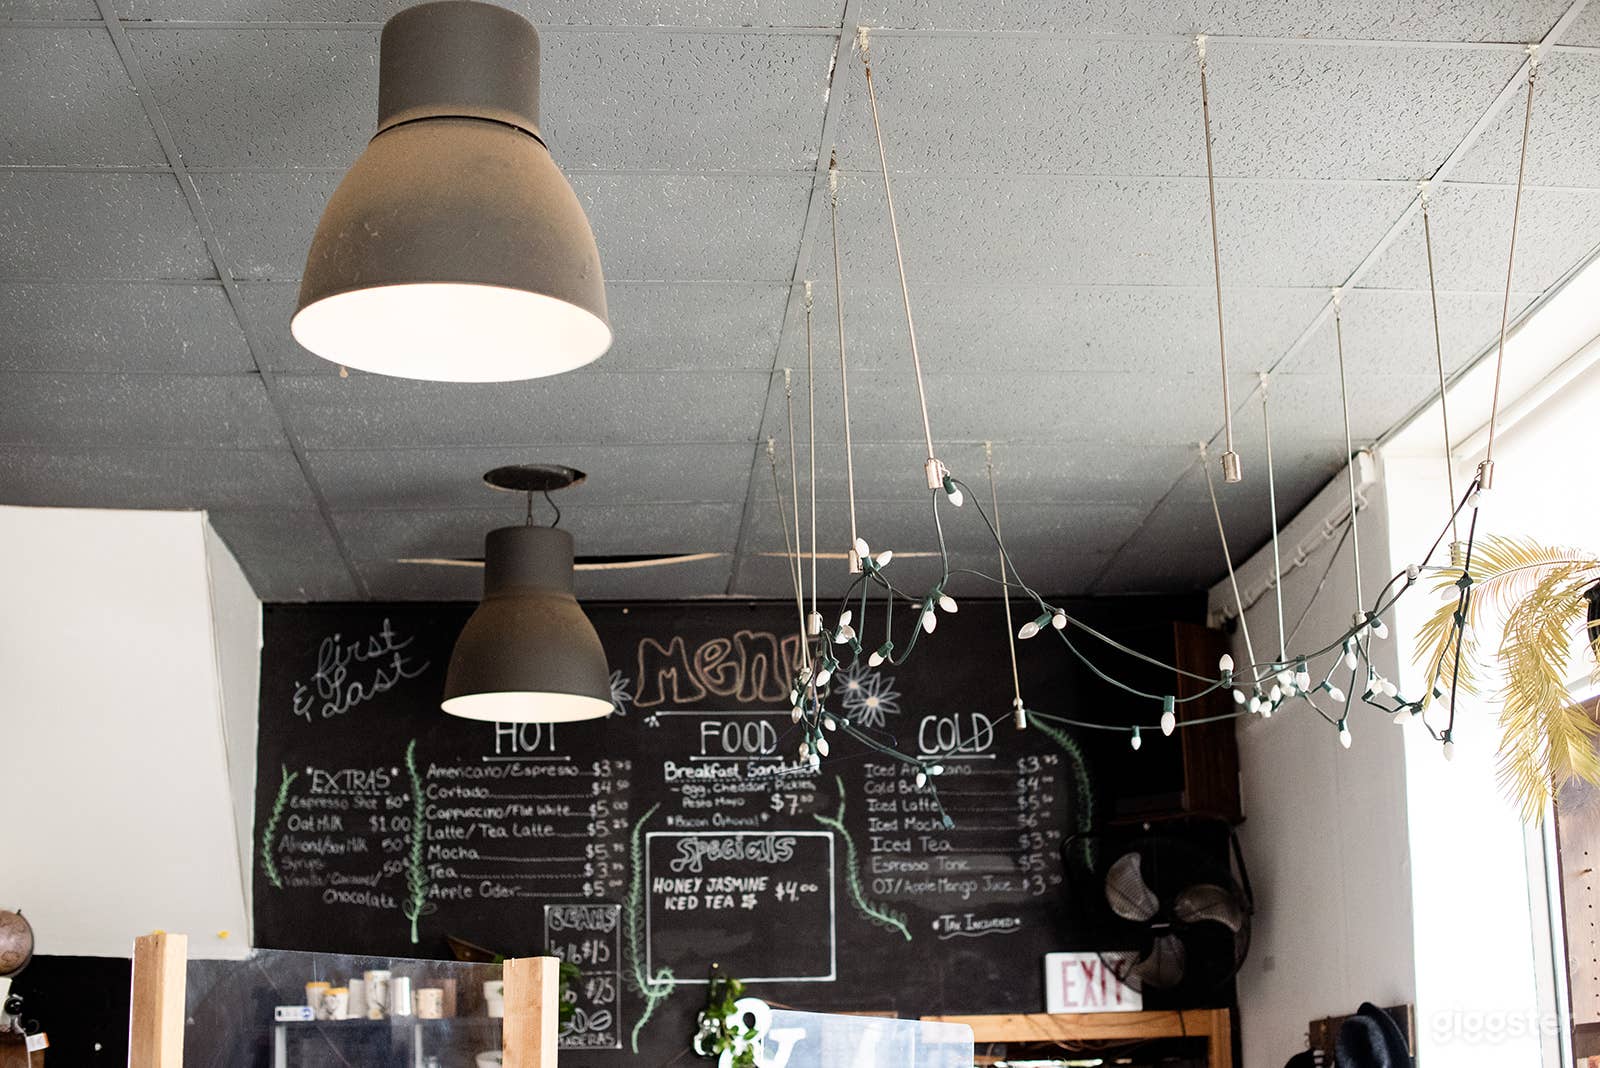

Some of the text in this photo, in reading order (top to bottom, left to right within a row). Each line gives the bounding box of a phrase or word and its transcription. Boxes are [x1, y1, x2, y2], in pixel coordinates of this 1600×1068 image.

[700, 719, 778, 755] FOOD
[918, 712, 994, 754] COLD
[663, 760, 741, 780] Breakfast
[863, 763, 896, 778] Iced
[312, 767, 392, 793] EXTRAS
[863, 780, 896, 796] Cold
[425, 783, 490, 799] Cortado
[865, 797, 898, 812] Iced
[902, 797, 939, 812] Latte
[478, 823, 508, 838] Tea
[512, 822, 555, 838] Latte
[868, 817, 899, 832] Iced
[904, 816, 946, 831] Moch
[870, 836, 912, 852] Iced
[919, 836, 953, 852] Tea
[427, 844, 480, 861] Mocha
[670, 835, 797, 872] Specials
[428, 863, 458, 879] Tea
[871, 855, 929, 874] Espresso
[428, 883, 473, 899] Apple
[653, 877, 703, 894] HONEY
[706, 876, 769, 893] JASMINE
[664, 895, 735, 911] ICED TEA
[1061, 959, 1126, 1009] EXIT
